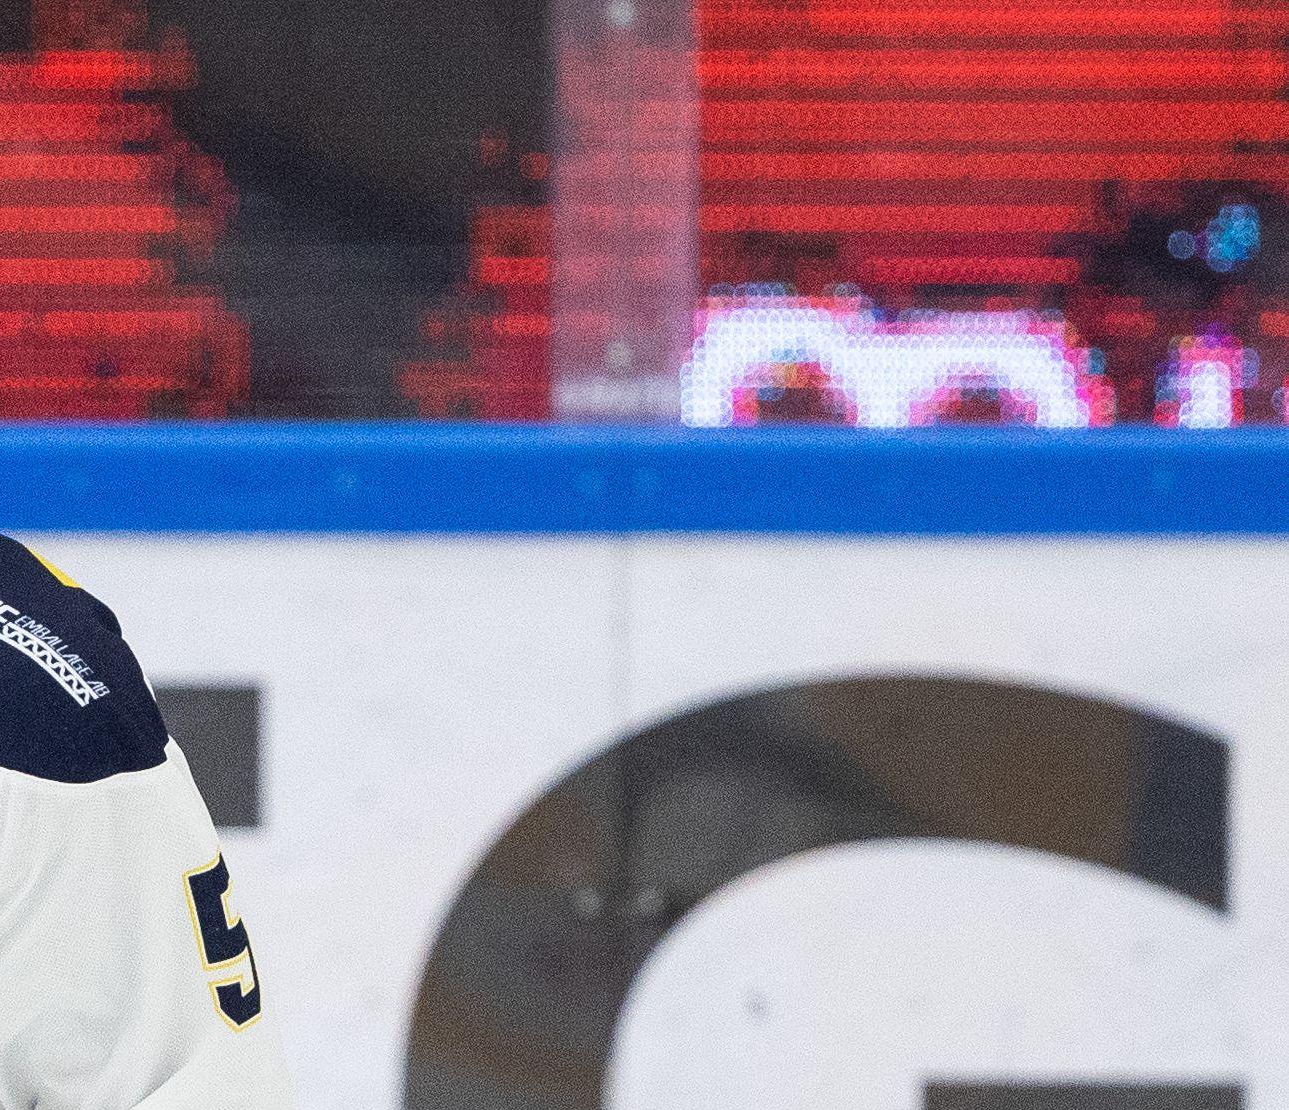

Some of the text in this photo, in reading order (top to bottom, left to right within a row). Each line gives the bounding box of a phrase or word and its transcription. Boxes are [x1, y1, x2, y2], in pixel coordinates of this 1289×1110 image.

[15, 614, 95, 677] EMBALLAGE
[87, 679, 111, 698] AB
[181, 845, 263, 1034] 5
